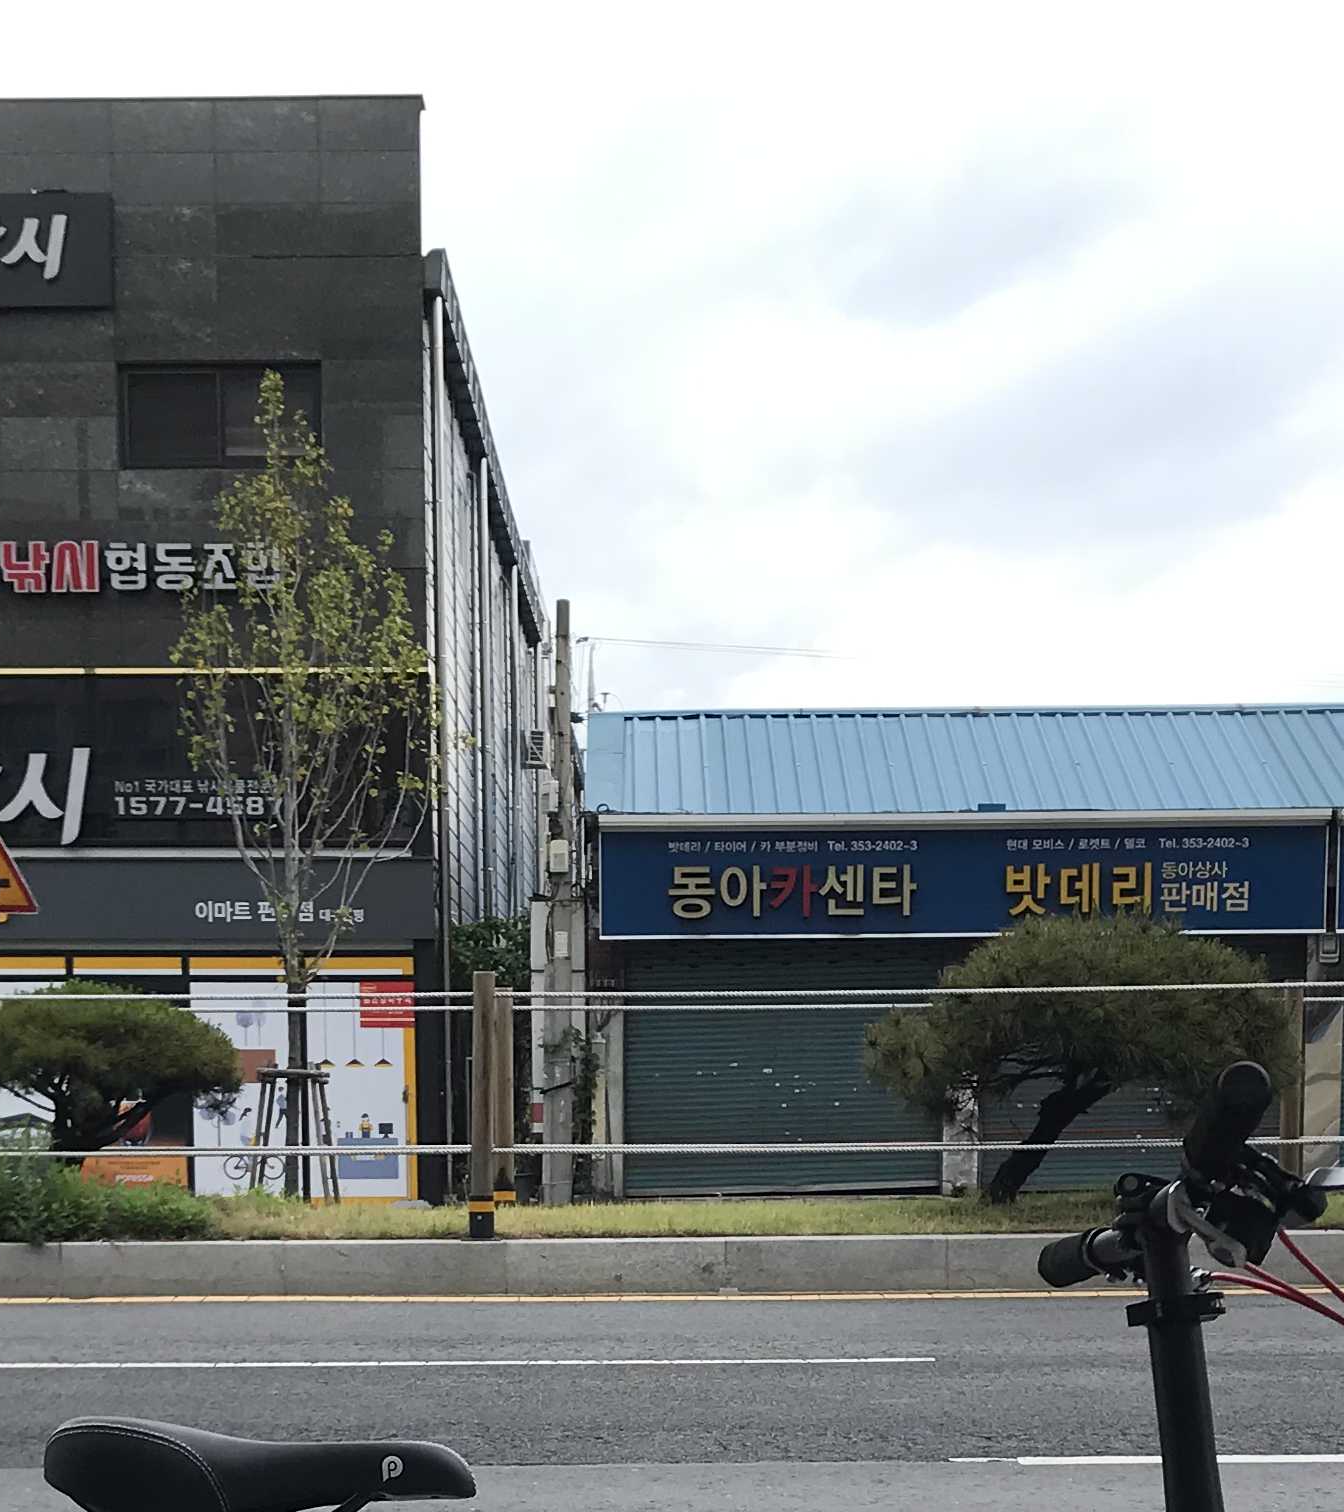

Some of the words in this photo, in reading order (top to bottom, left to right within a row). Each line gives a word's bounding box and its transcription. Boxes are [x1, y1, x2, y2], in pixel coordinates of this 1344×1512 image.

[1159, 837, 1179, 849] Tel.
[1161, 861, 1228, 879] 동아상사
[668, 863, 917, 919] 동아카센타
[1160, 880, 1250, 912] 판매점
[195, 901, 252, 922] 이마트
[257, 901, 314, 922] 편점
